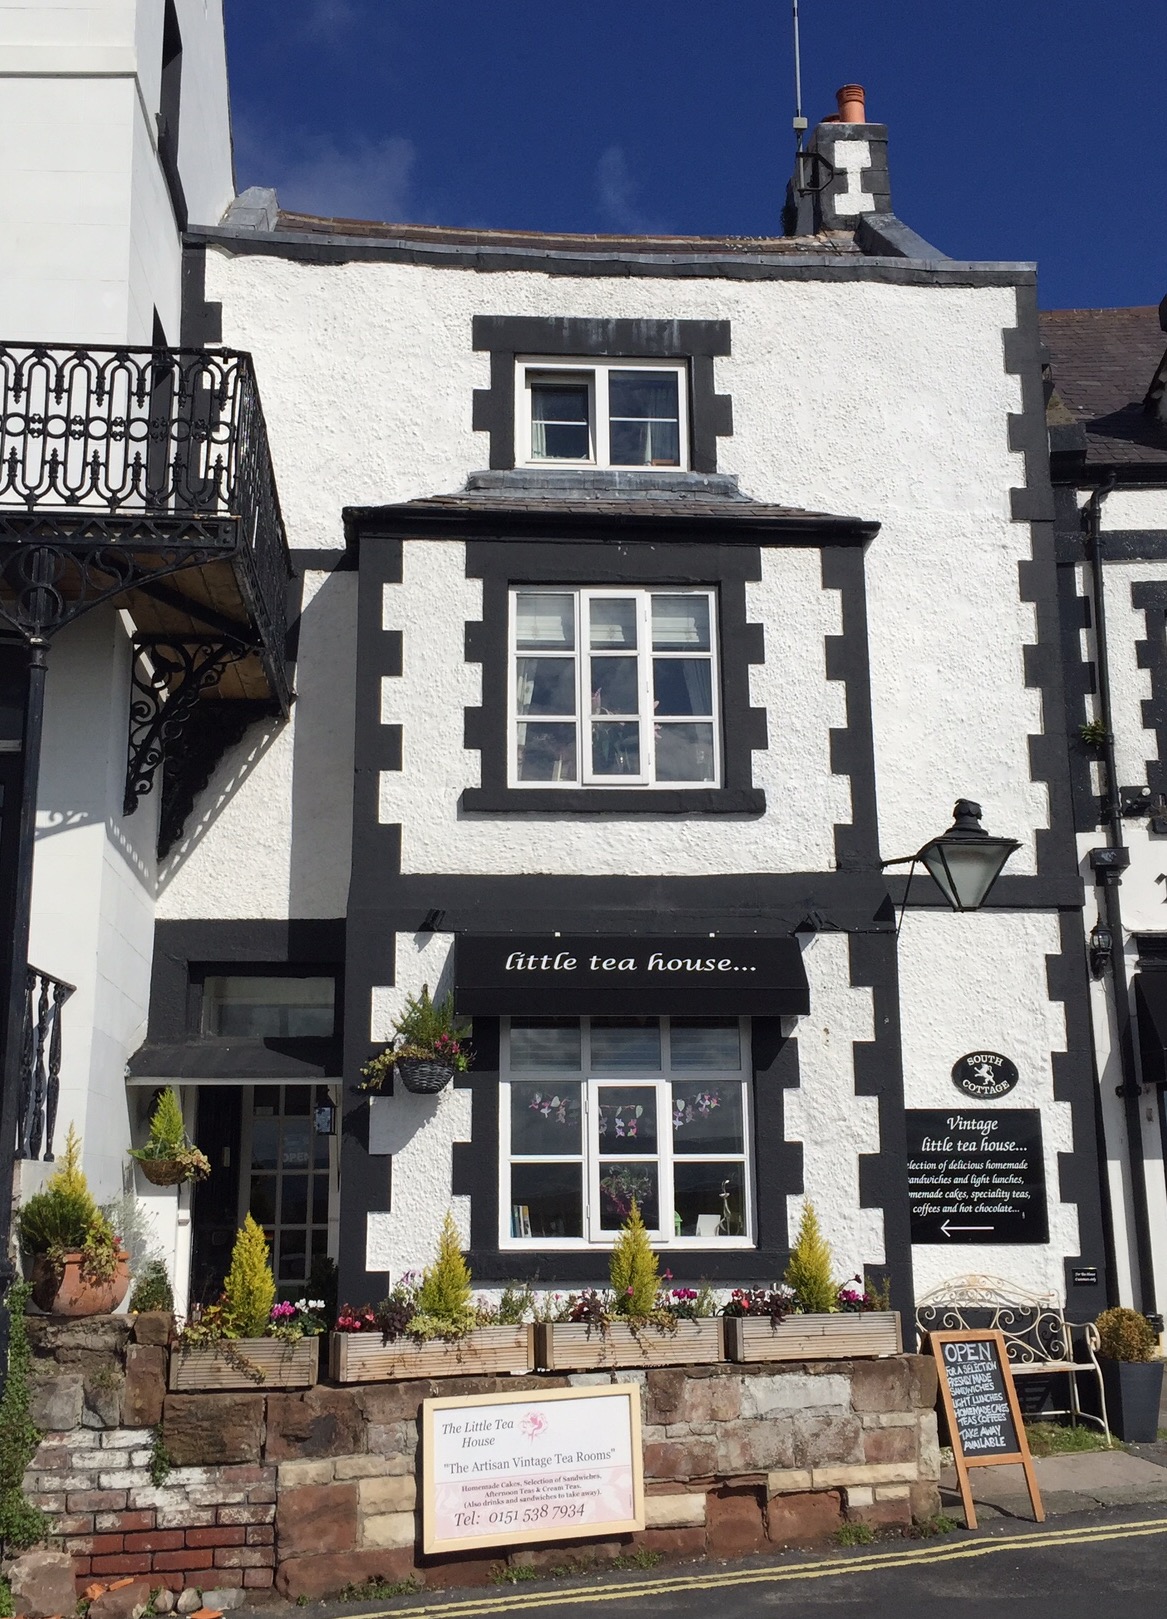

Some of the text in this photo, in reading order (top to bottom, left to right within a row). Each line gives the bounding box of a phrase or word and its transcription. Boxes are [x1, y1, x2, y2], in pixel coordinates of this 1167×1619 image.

[505, 951, 757, 972] little tea house...
[966, 1054, 1004, 1067] SOUTH
[962, 1079, 1010, 1095] COTTAGE
[946, 1115, 999, 1135] Vintage
[921, 1136, 1028, 1152] little tea house...
[906, 1159, 1029, 1173] lection of delicious homemade
[953, 1174, 970, 1184] and
[970, 1173, 990, 1188] light
[991, 1173, 1025, 1185] lunches,
[908, 1188, 1031, 1202] memade cakes, speciality teas,
[912, 1202, 1020, 1217] coffees and hot chocolate...
[944, 1342, 992, 1363] OPEN
[962, 1361, 997, 1375] SELECTION
[972, 1372, 993, 1385] MADE
[950, 1382, 995, 1397] SANDWICHES
[952, 1393, 1004, 1409] LIGHT LUNCHES
[953, 1405, 992, 1418] HOMEMADE
[441, 1419, 514, 1435] The Little Tea
[958, 1415, 978, 1427] TEAS
[959, 1425, 1001, 1440] TAKE AWAY
[461, 1436, 496, 1449] House
[963, 1436, 1007, 1452] AVAILABLE
[444, 1448, 616, 1475] "The Artisan Vintage Tea Rooms"
[461, 1483, 500, 1492] Homemade
[523, 1477, 555, 1486] Selection
[554, 1476, 562, 1484] of
[485, 1490, 519, 1498] Afternoon
[519, 1488, 535, 1496] Teas
[535, 1486, 541, 1494] &
[542, 1485, 564, 1493] Cream
[463, 1500, 482, 1509] (Also
[482, 1497, 505, 1507] drinks
[505, 1495, 519, 1504] and
[519, 1492, 558, 1503] sandwiches
[558, 1491, 565, 1499] to
[566, 1489, 580, 1498] take
[454, 1503, 585, 1527] Tel: 0151 538 7934
